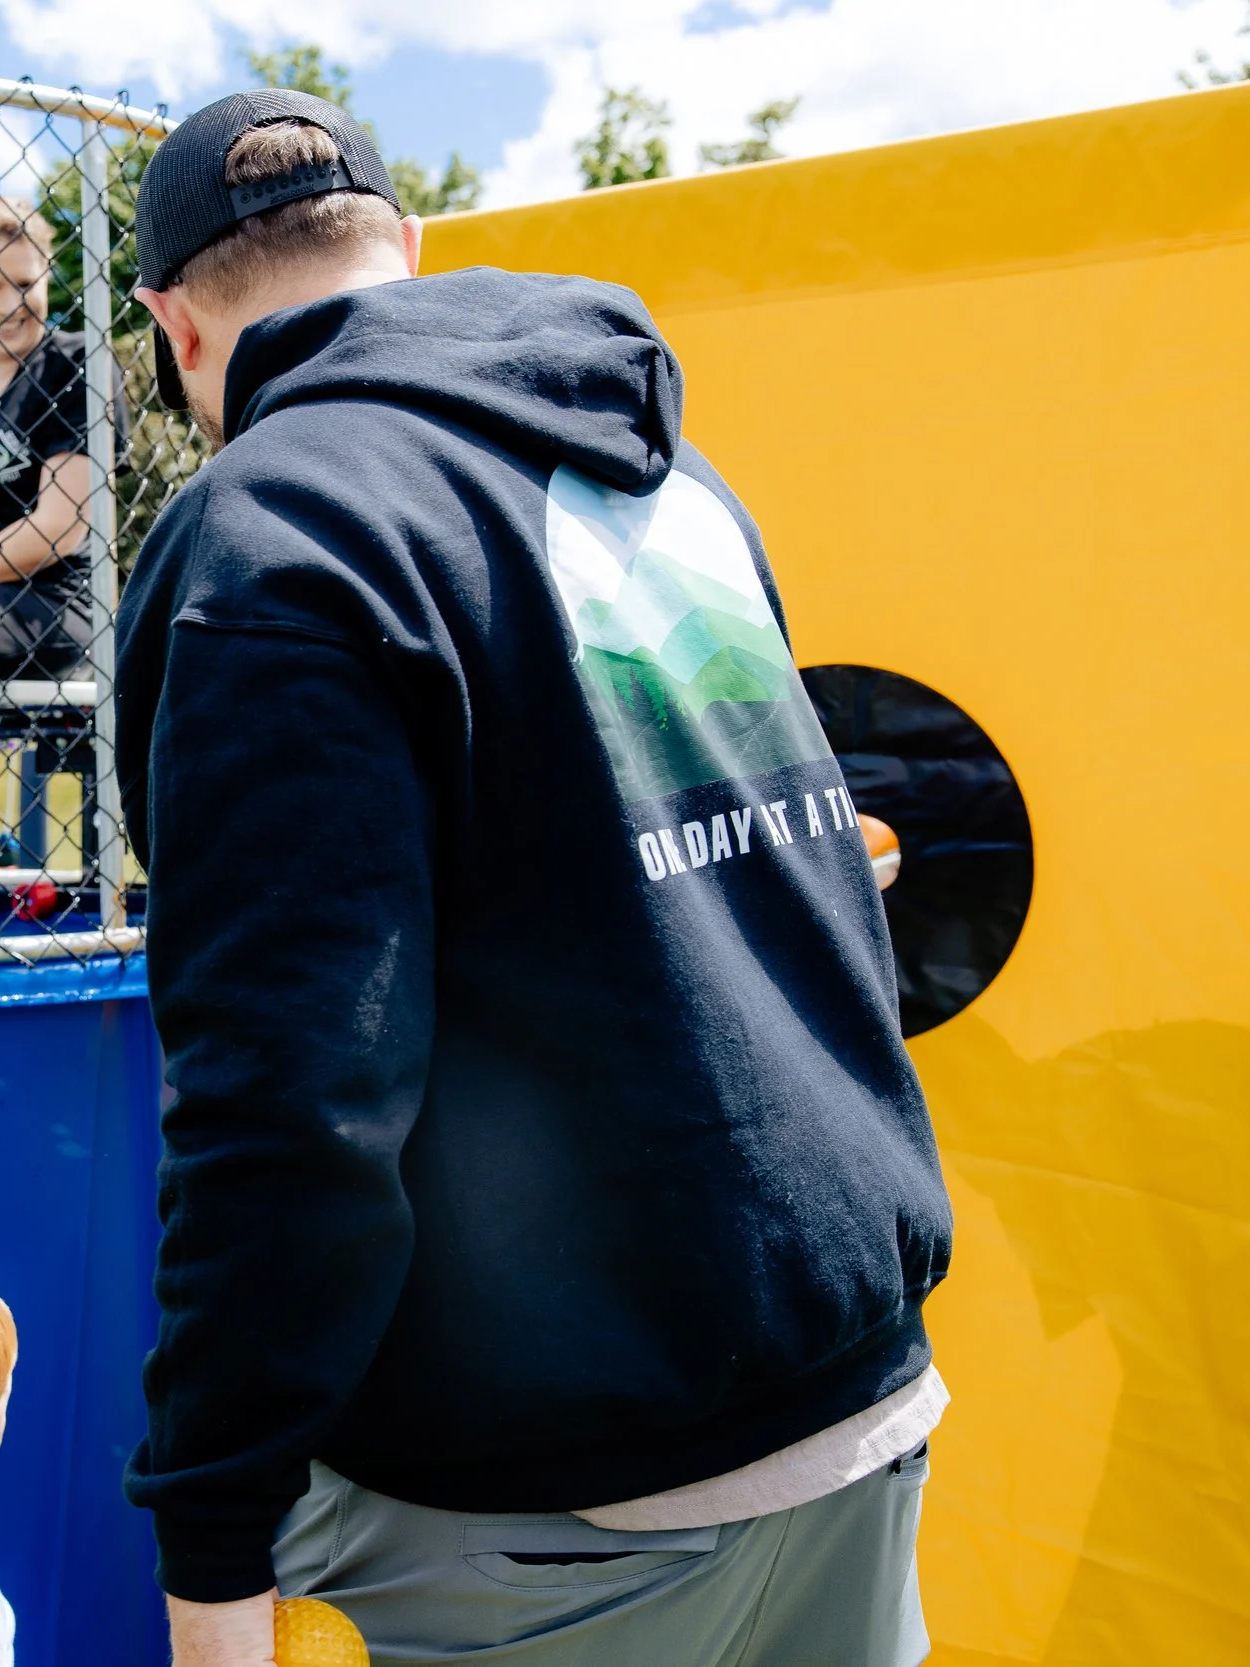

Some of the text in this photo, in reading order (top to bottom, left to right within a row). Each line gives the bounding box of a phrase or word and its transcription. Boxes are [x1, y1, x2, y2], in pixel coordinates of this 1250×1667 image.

[682, 807, 752, 869] DAY
[760, 800, 794, 847] AT
[804, 793, 824, 838] A
[824, 786, 860, 831] TI
